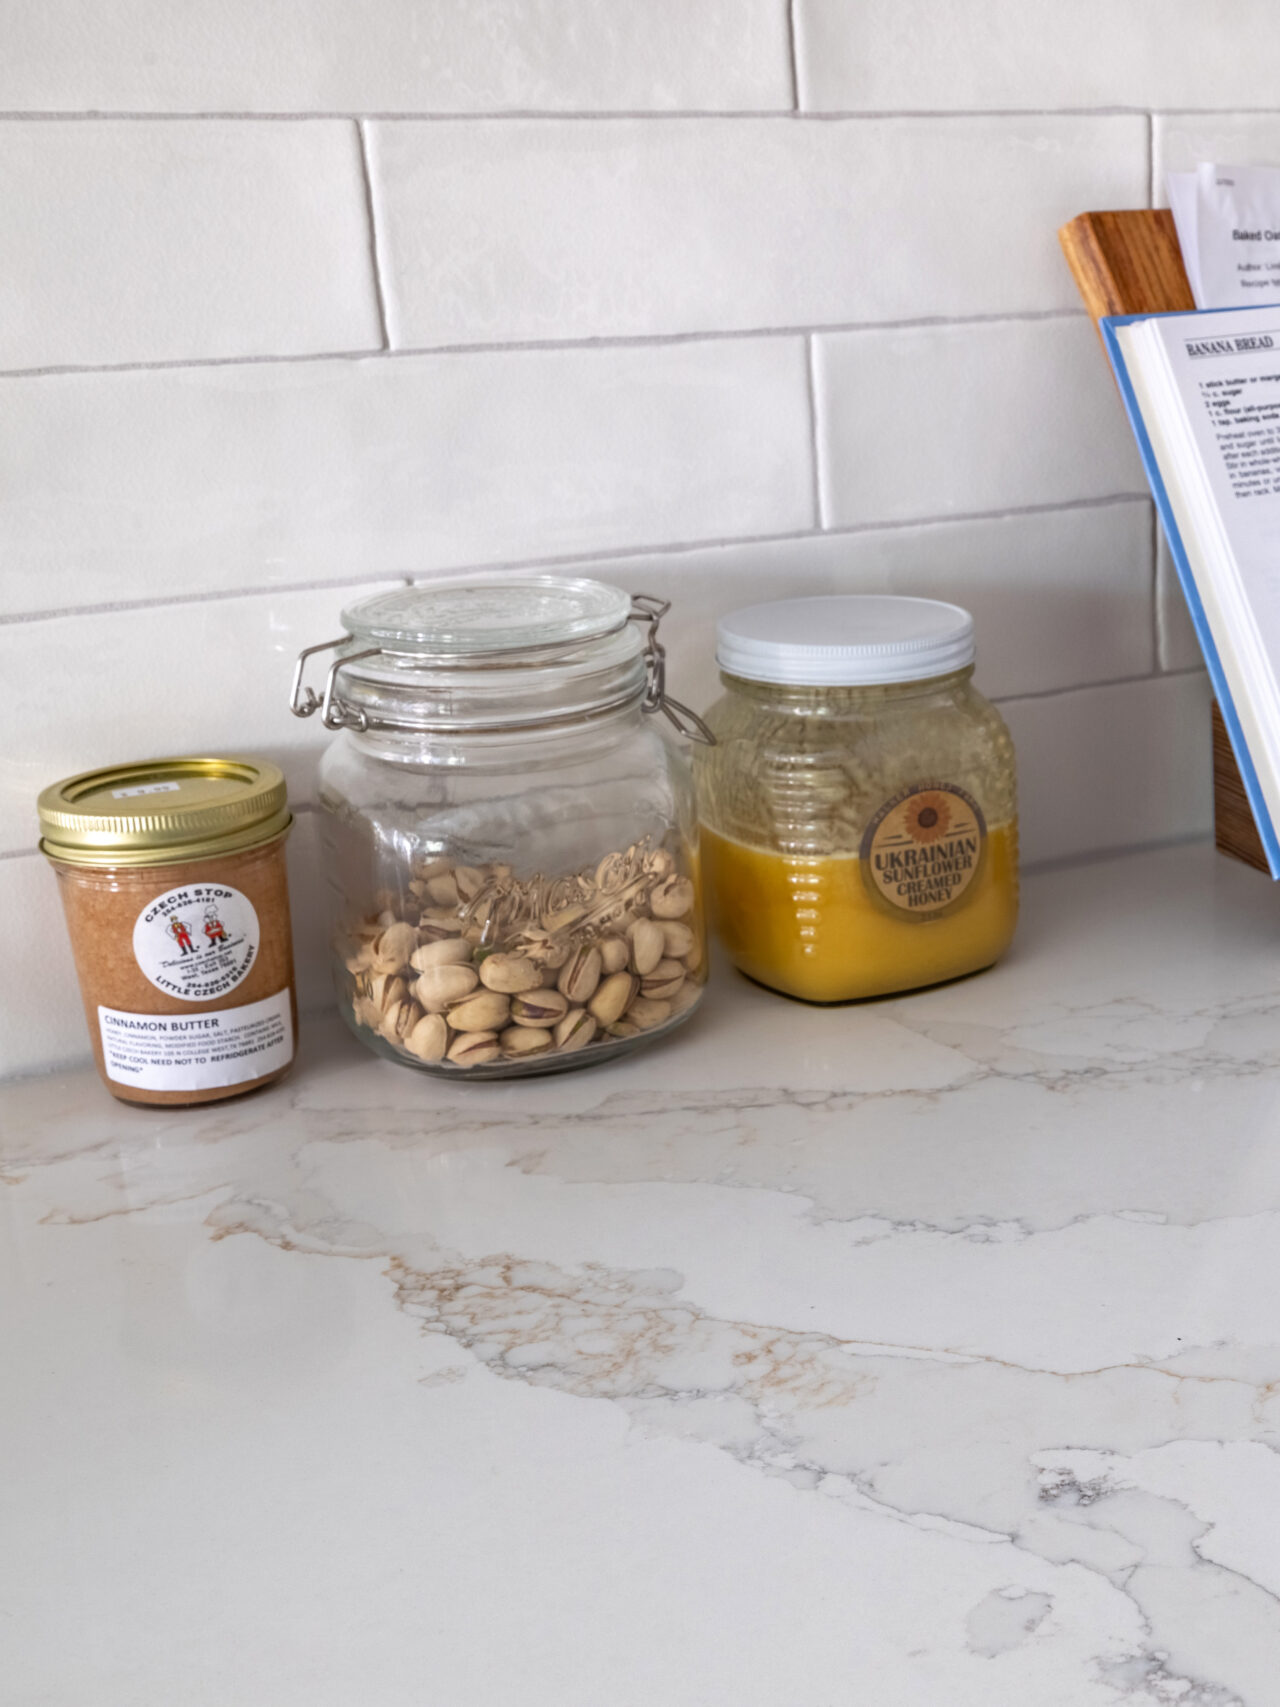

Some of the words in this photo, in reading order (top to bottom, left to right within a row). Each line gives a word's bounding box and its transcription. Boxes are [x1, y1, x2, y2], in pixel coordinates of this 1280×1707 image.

[1232, 229, 1262, 242] Baked
[1185, 340, 1234, 357] BANANA
[1234, 335, 1274, 351] BREAD
[874, 837, 977, 871] UKRAINIAN
[882, 855, 972, 884] SUNFLOWER
[896, 872, 962, 896] CREAMED
[145, 891, 188, 923] CZECH
[194, 888, 233, 899] STOP
[908, 888, 952, 907] HONEY
[155, 975, 191, 995] LITTLE
[194, 982, 230, 996] CZECH
[231, 945, 256, 983] BAKERY
[105, 1015, 167, 1032] CINNAMON
[170, 1018, 220, 1032] BUTTER
[128, 1056, 148, 1064] COOL
[150, 1058, 173, 1066] NEED
[174, 1058, 192, 1066] NOT
[210, 1043, 266, 1063] REFRIDGERATE
[266, 1035, 284, 1048] AFTER
